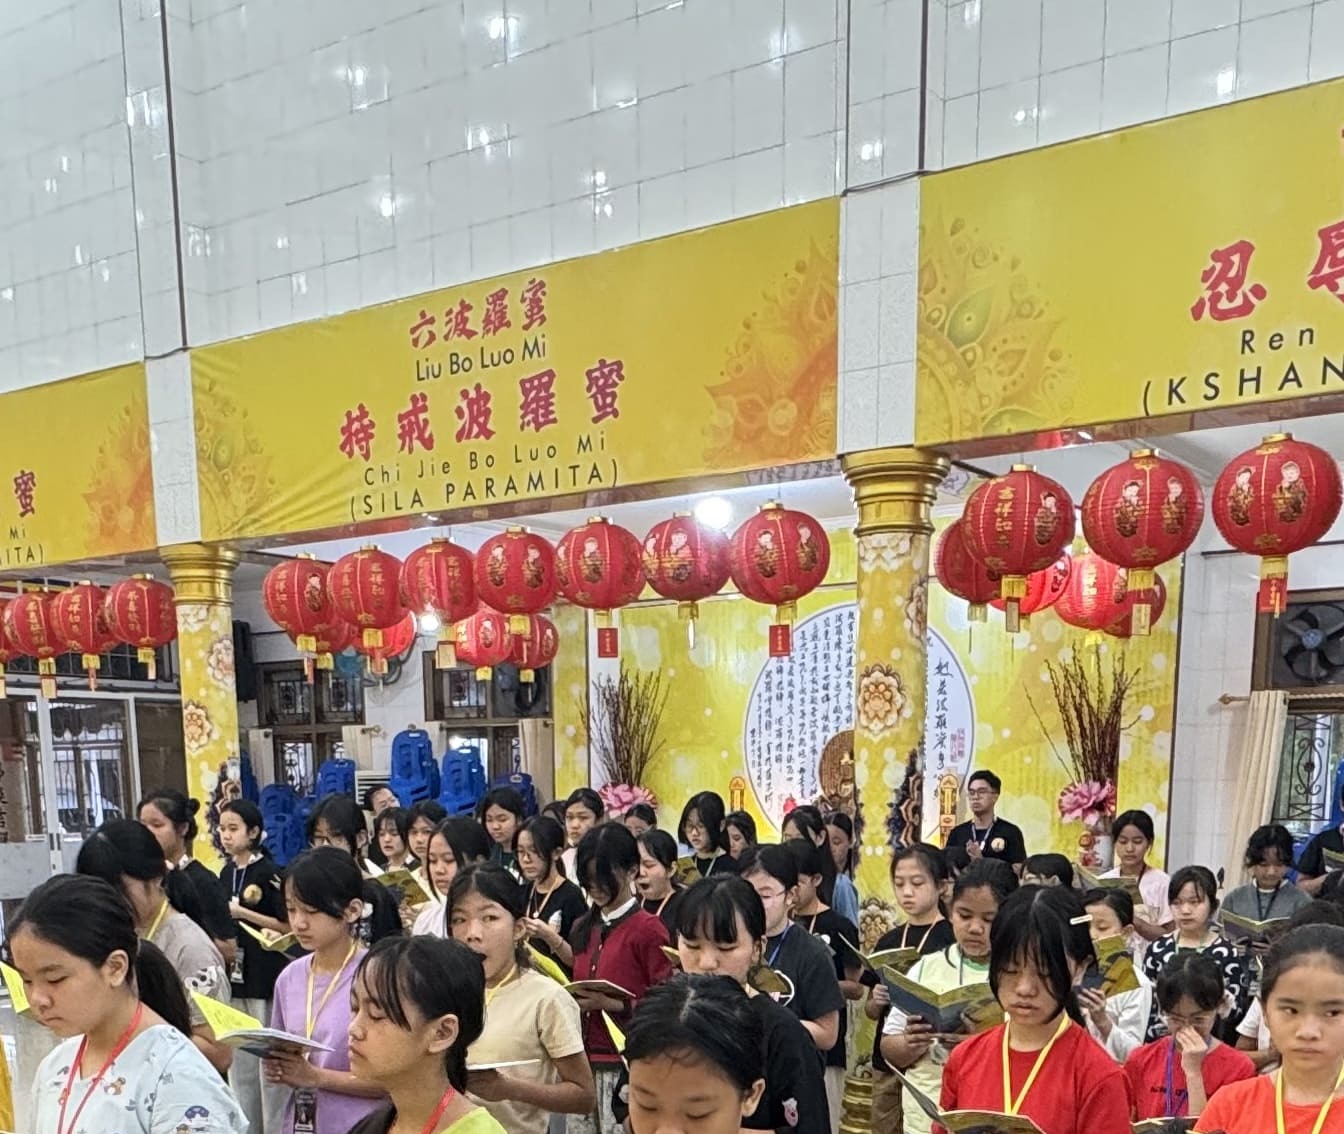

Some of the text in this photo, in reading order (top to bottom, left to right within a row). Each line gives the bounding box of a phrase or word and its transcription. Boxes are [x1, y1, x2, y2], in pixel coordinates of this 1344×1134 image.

[409, 277, 548, 350] 六波羅蜜
[1240, 327, 1315, 355] Ren
[416, 333, 547, 384] Liu Bo Luo Mi
[339, 358, 626, 462] 持戒波羅蜜
[364, 430, 606, 487] Chi Jie Bo Luo Mi
[350, 458, 619, 523] (SILA PARAMITA)
[9, 523, 26, 540] Mi
